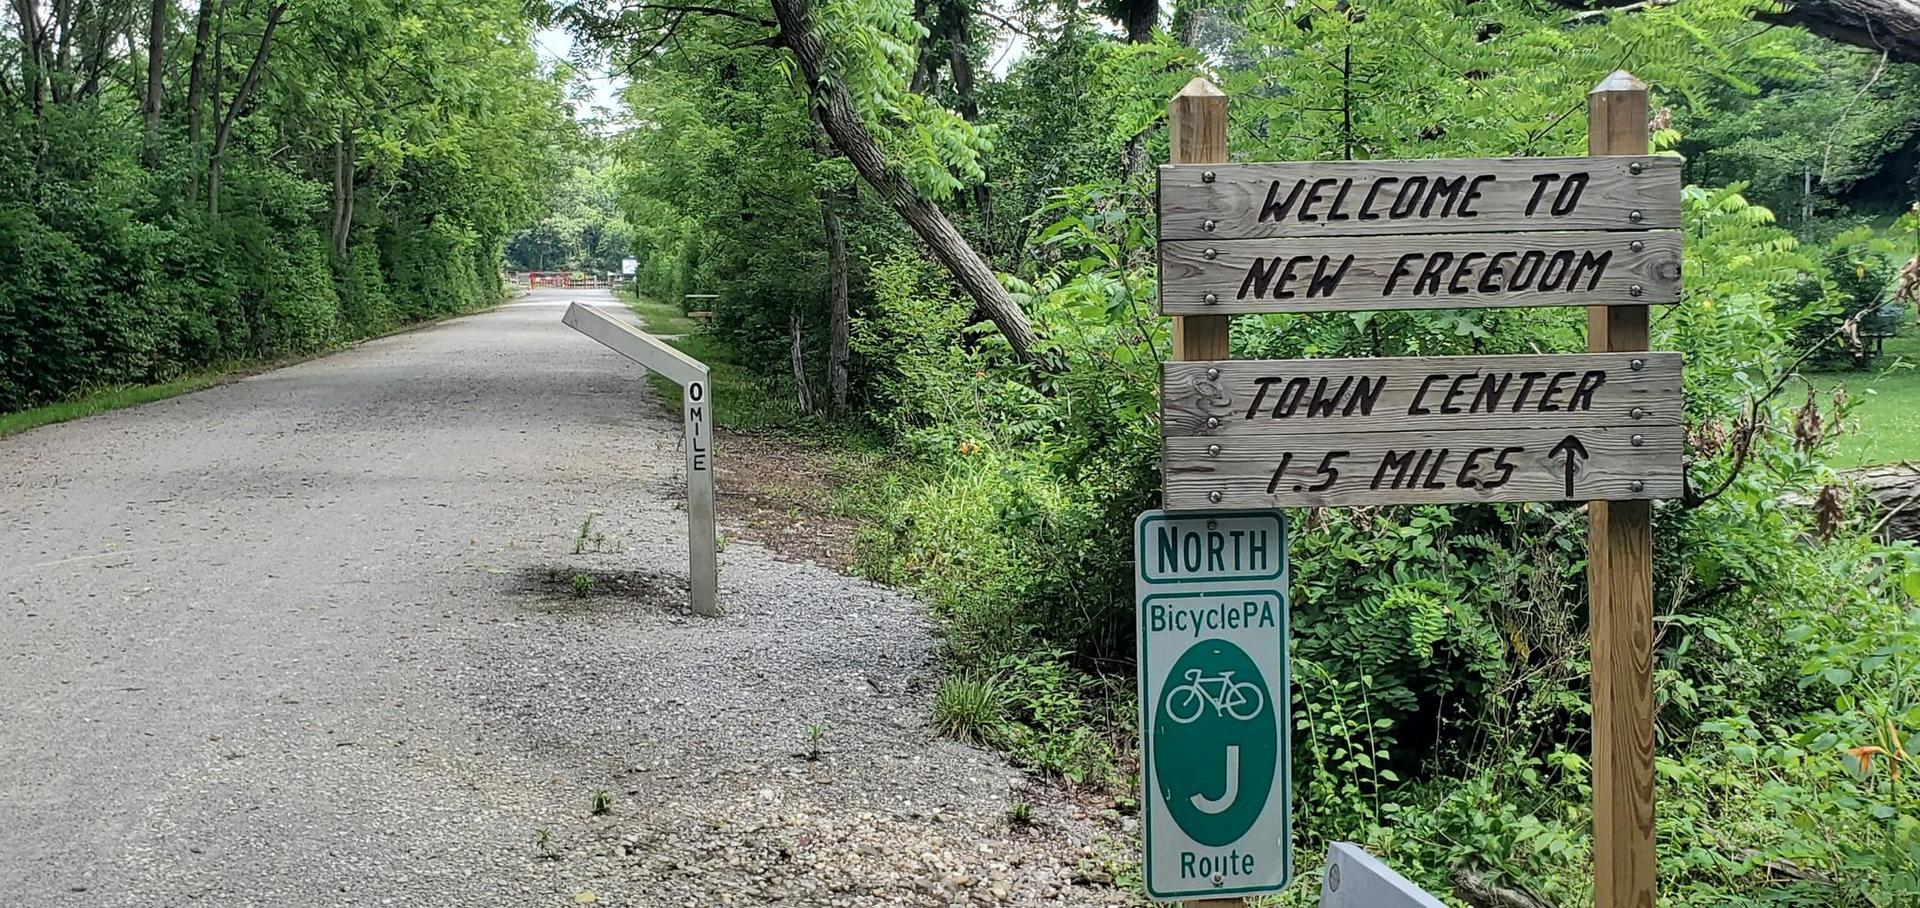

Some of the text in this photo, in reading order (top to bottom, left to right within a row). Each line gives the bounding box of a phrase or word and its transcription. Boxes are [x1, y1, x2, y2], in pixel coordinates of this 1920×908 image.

[1257, 171, 1591, 224] WELCOME TO
[1236, 249, 1614, 301] NEW FREEDOM
[1244, 369, 1607, 421] TOWN CENTER
[690, 407, 706, 470] MILE
[1266, 446, 1526, 496] 1.5 MILES
[1157, 526, 1268, 574] NORTH
[1150, 601, 1276, 638] BicyclePA
[1189, 745, 1240, 815] J
[1180, 850, 1255, 880] Route
